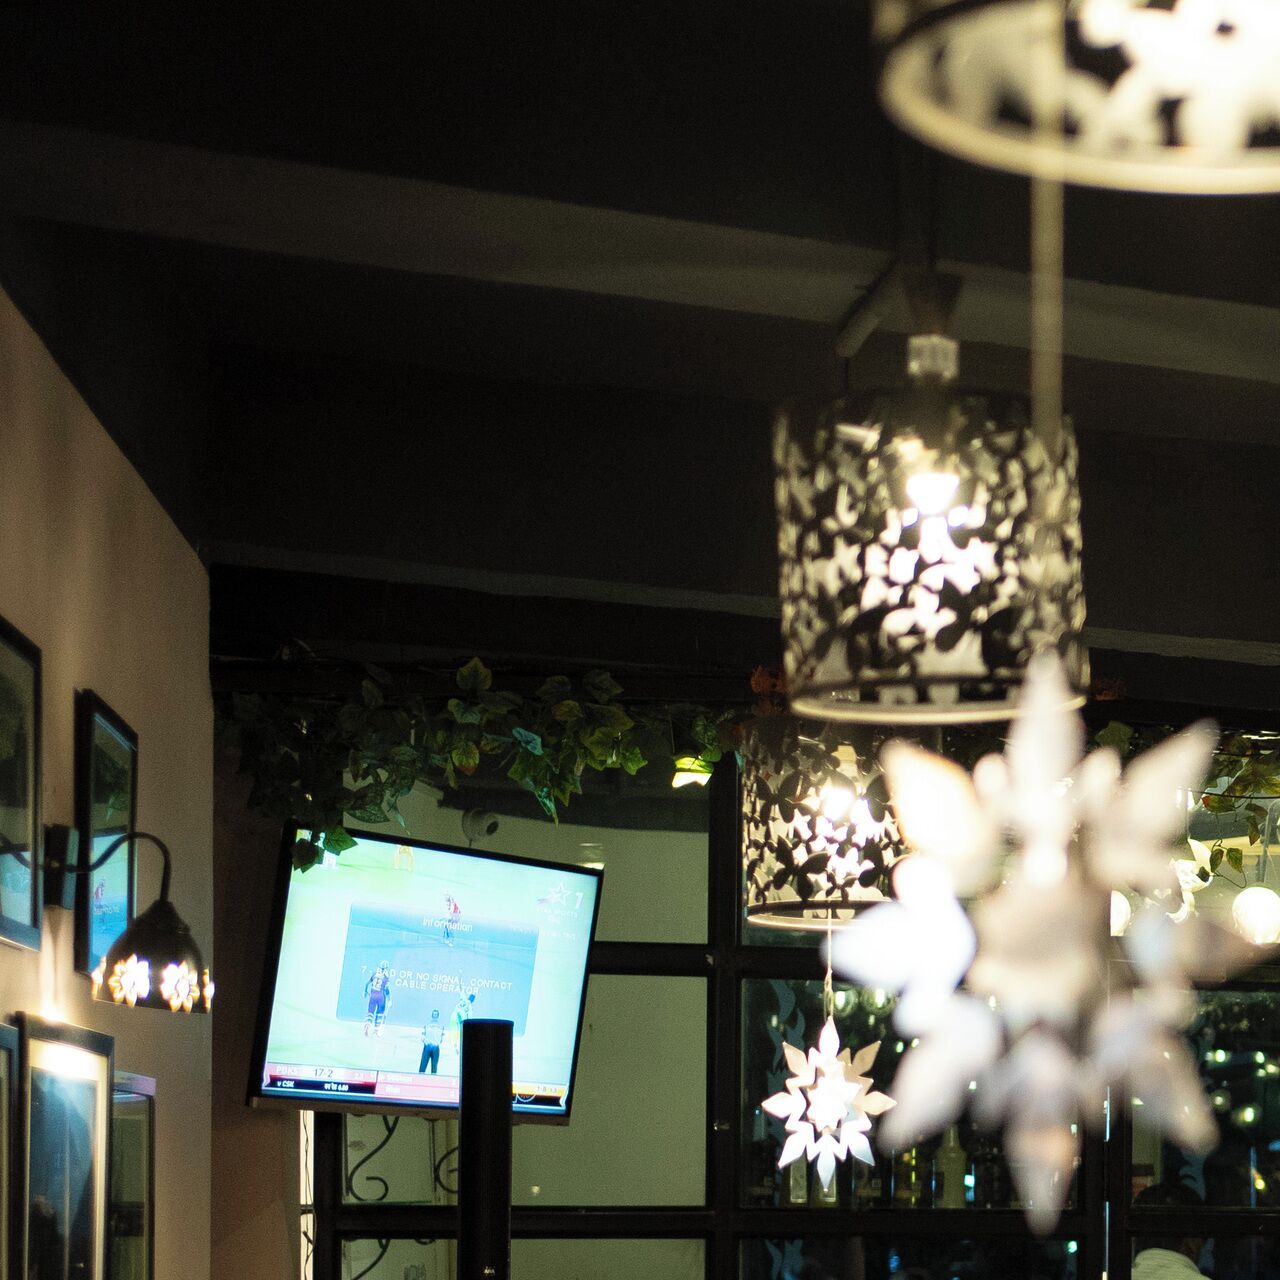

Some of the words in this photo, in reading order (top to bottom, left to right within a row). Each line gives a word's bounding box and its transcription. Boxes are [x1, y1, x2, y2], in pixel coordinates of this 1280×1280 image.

[376, 967, 396, 978] BAD
[400, 970, 413, 979] OR
[416, 971, 430, 982] NO
[470, 978, 513, 991] CONTACT
[394, 979, 427, 990] CABLE
